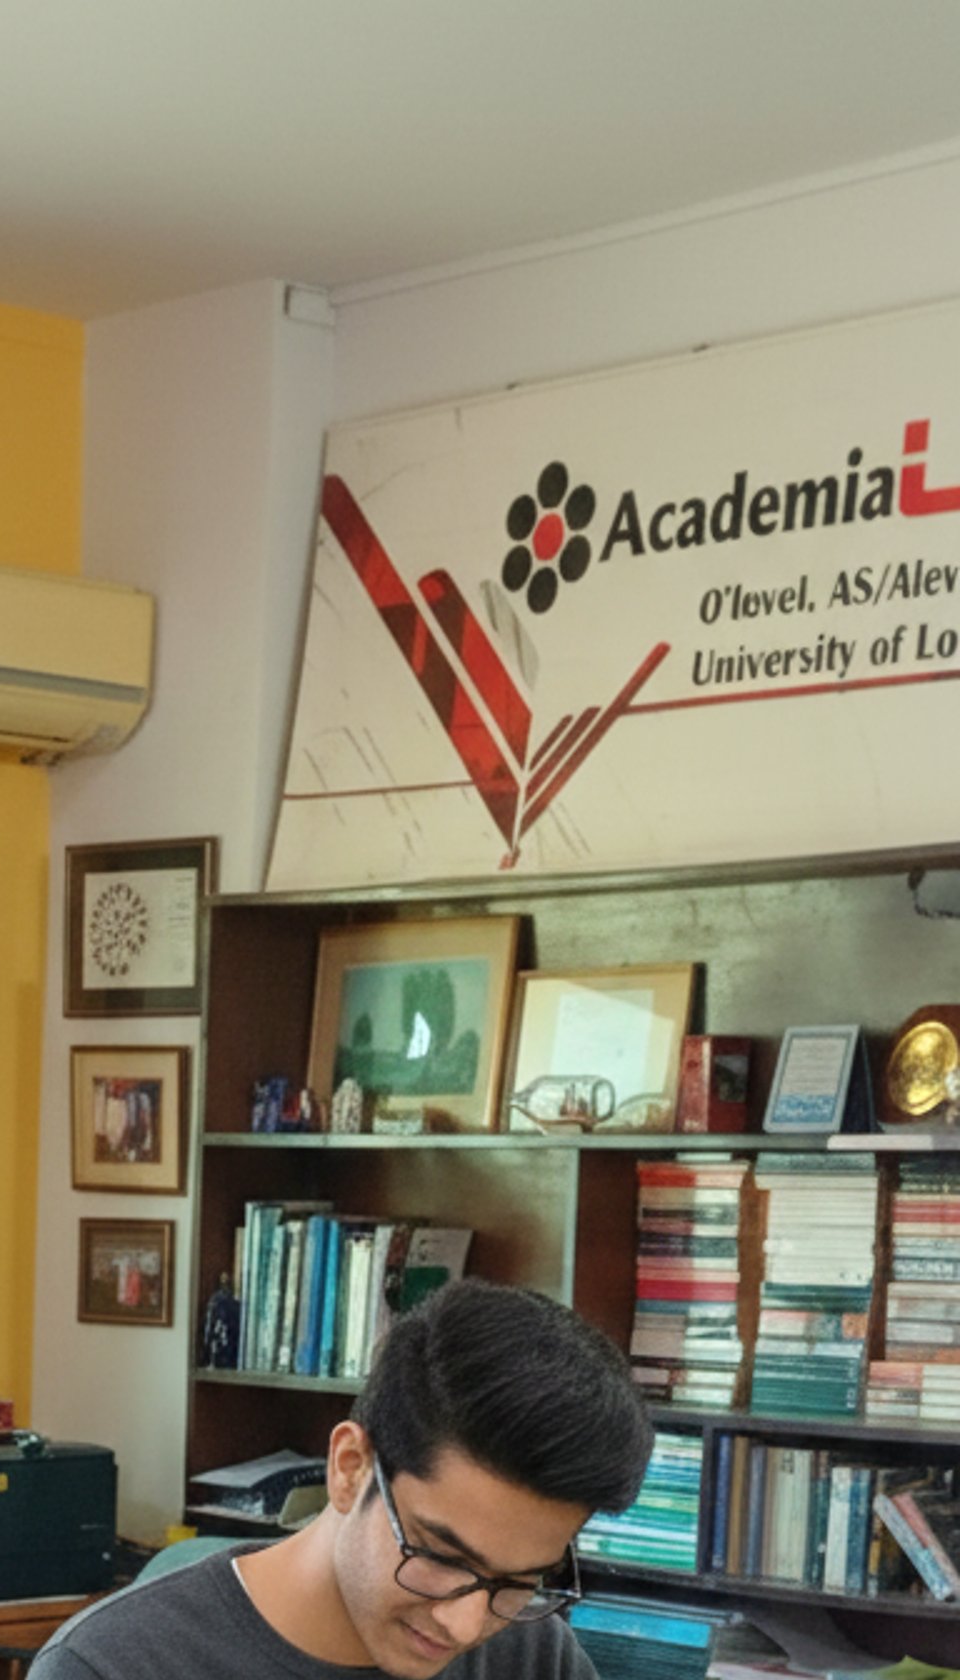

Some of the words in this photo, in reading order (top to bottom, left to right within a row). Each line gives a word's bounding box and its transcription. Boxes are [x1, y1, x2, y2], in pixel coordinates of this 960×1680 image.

[692, 633, 856, 686] University
[870, 624, 908, 666] of
[916, 623, 959, 660] Lo
